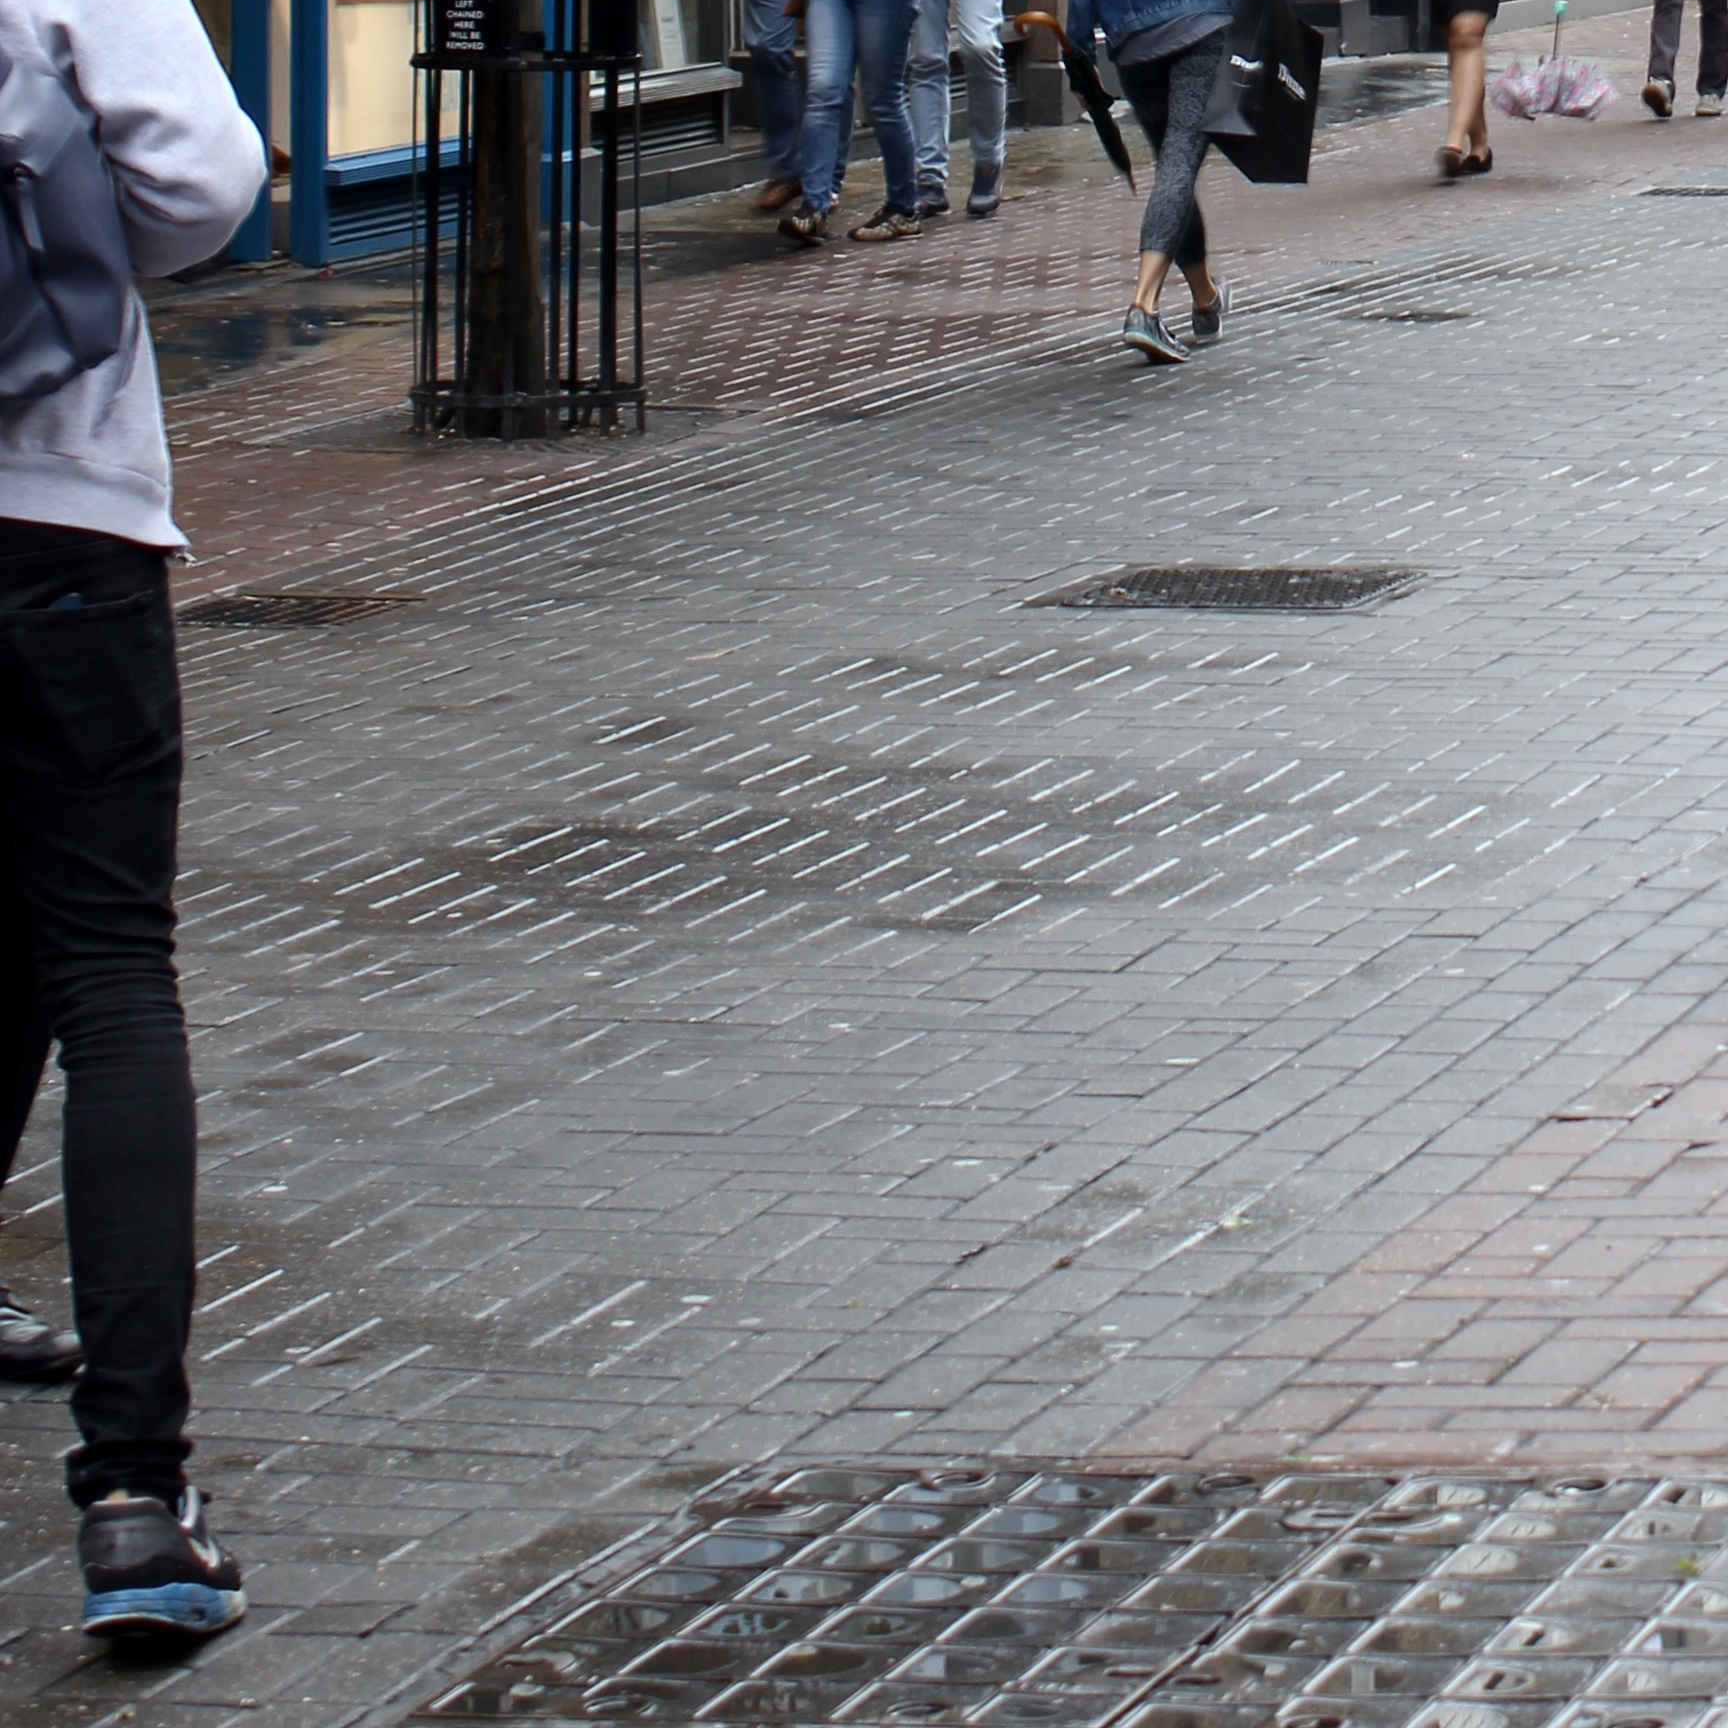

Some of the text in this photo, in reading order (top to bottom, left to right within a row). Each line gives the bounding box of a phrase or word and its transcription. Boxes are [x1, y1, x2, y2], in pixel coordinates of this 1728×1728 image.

[446, 10, 484, 18] CHAINED
[454, 21, 475, 29] HERE
[449, 31, 480, 39] WILL BE
[446, 42, 484, 50] REMOVED
